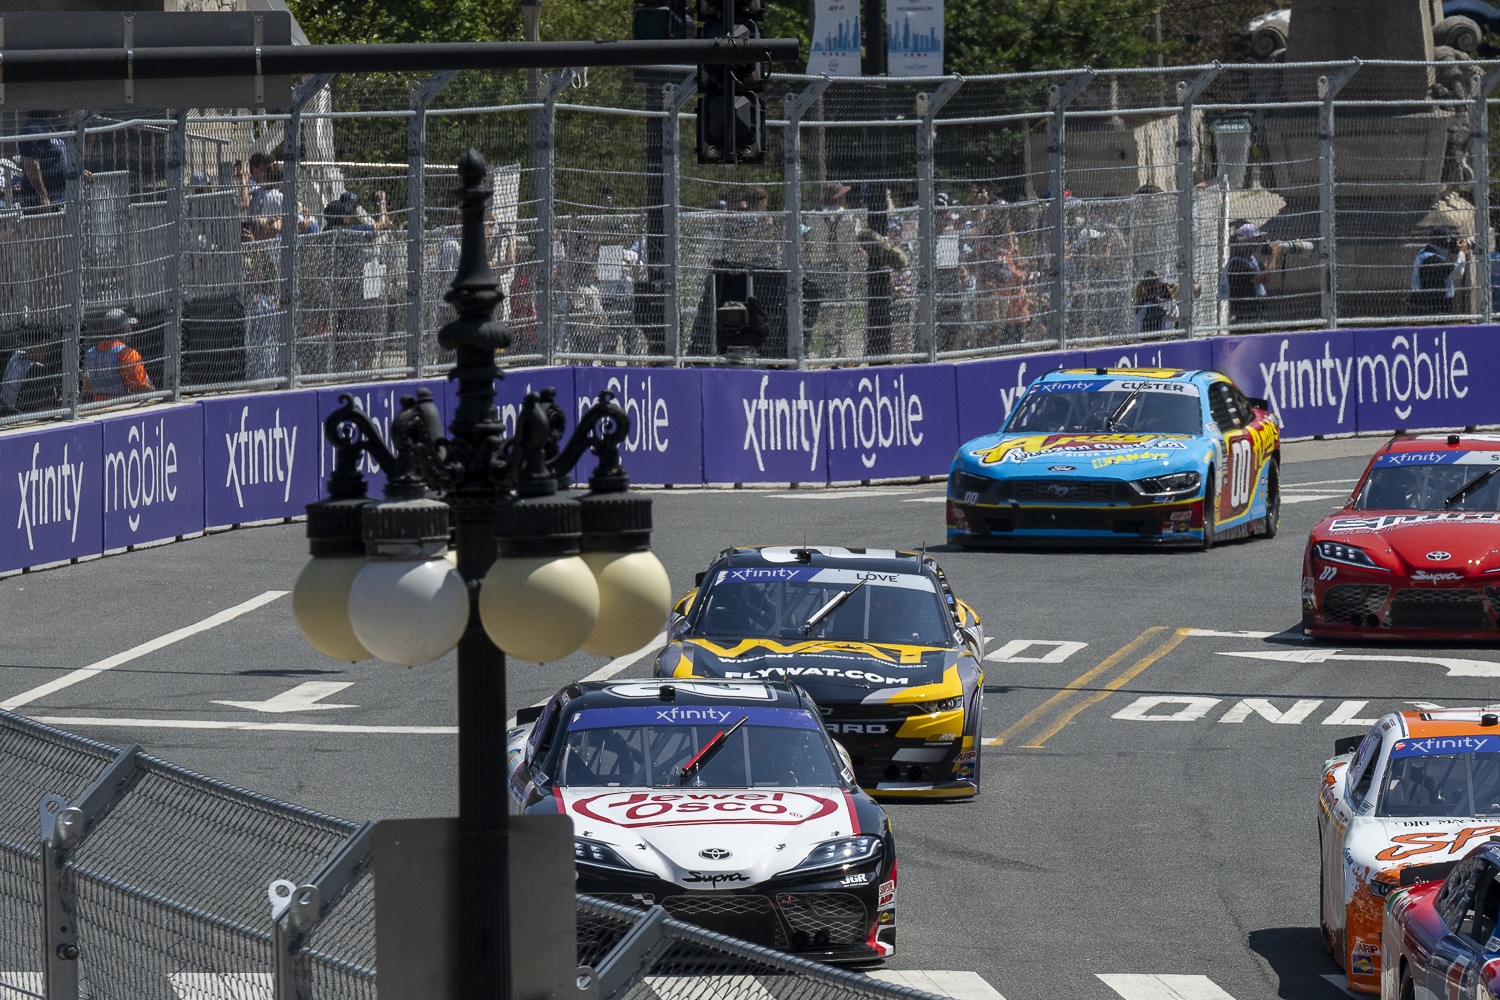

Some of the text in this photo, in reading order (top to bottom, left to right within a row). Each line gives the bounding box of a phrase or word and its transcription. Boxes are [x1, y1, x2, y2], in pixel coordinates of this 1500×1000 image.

[1040, 380, 1184, 392] xfinity CUSTER
[1260, 332, 1468, 428] xfinity môbile
[742, 375, 824, 472] xfinity
[828, 373, 924, 469] môbile
[225, 405, 298, 508] xfinity
[1388, 452, 1446, 465] xfinity
[1231, 439, 1251, 508] 00
[17, 417, 178, 551] xfinity môbile
[965, 492, 979, 504] 00
[731, 568, 898, 582] xfinity LOVE
[1319, 566, 1337, 581] 81
[1411, 570, 1464, 585] Supra
[725, 667, 909, 685] FLYWAT.COM
[656, 708, 732, 723] xfinity
[1411, 737, 1489, 753] xfinity
[955, 752, 977, 762] ARP
[608, 793, 784, 808] Jewel
[682, 870, 751, 889] Supra
[840, 873, 868, 885] JGR
[1358, 942, 1379, 954] ARP
